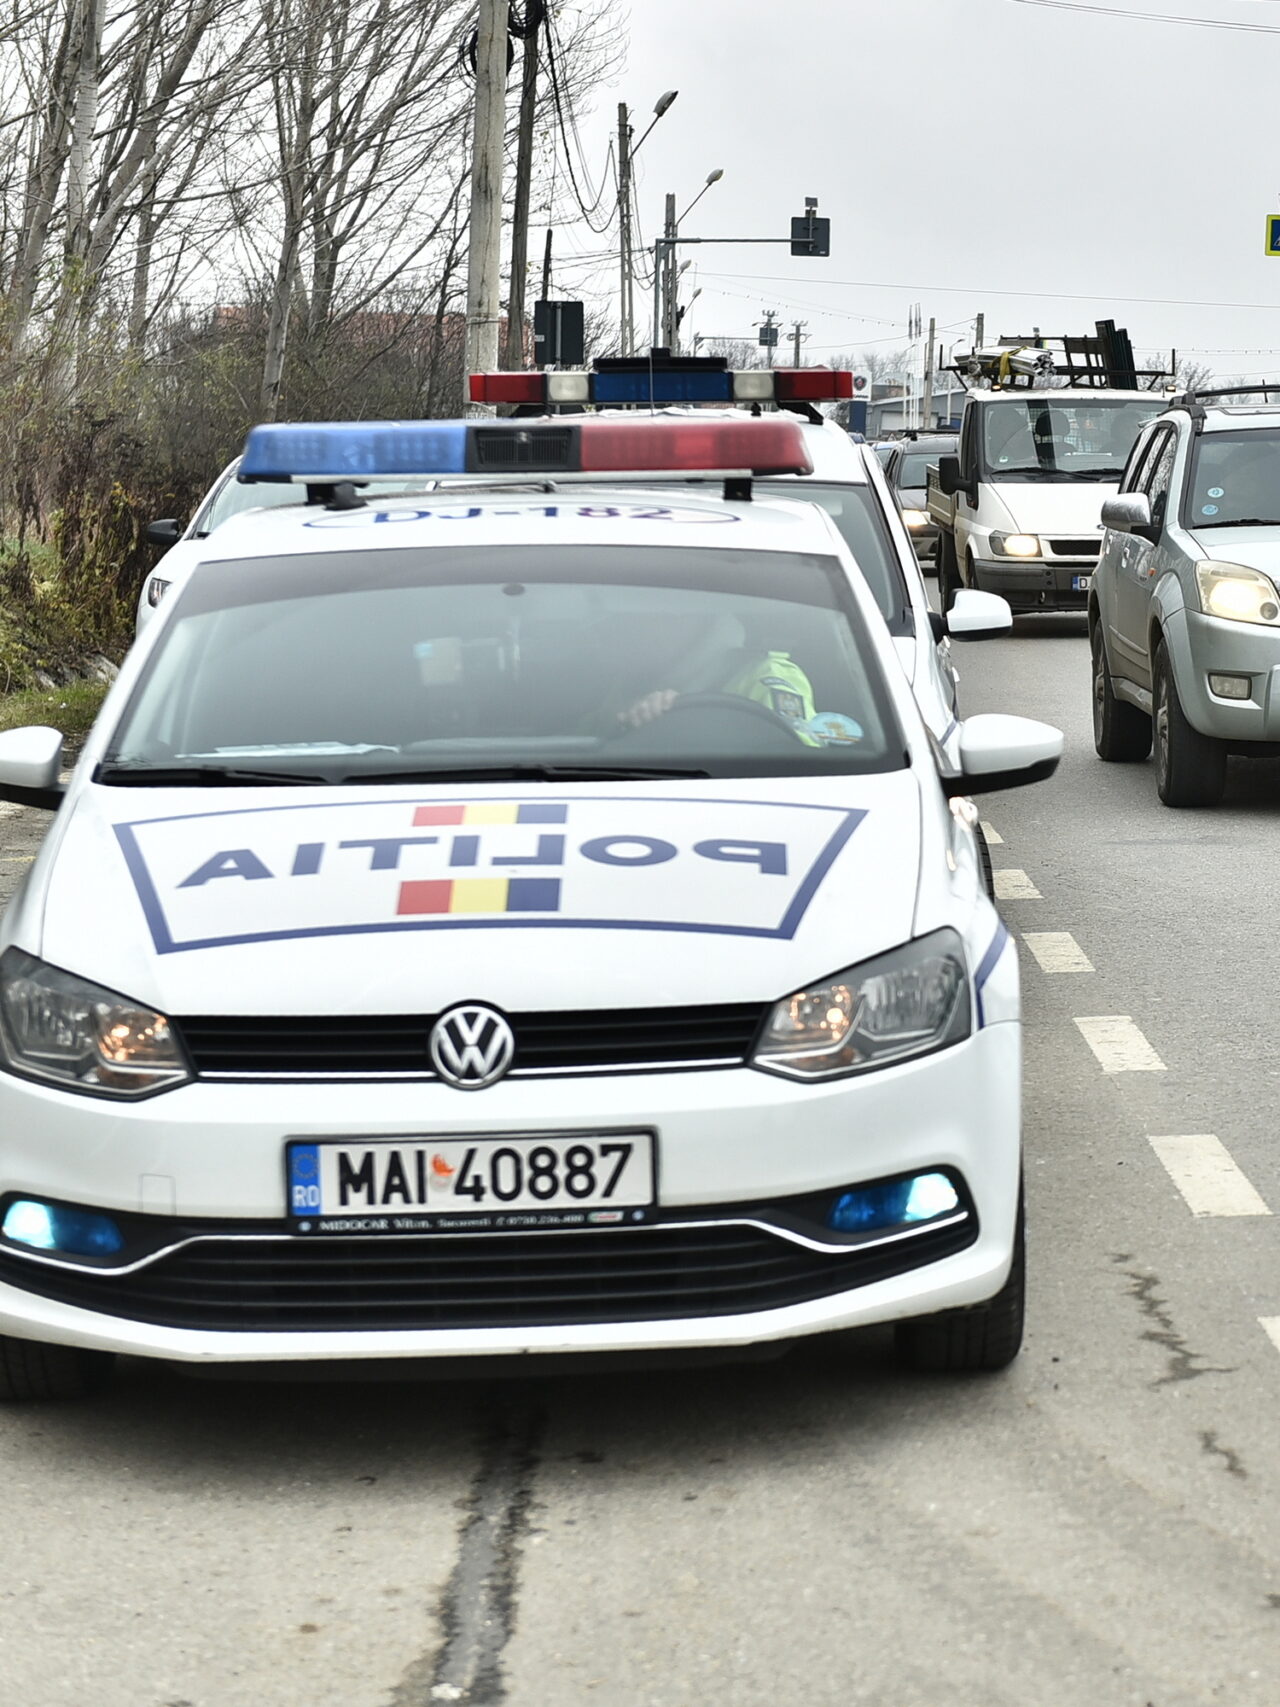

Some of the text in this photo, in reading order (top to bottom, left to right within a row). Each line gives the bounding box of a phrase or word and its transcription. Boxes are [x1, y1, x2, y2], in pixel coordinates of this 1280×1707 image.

[374, 506, 673, 523] DJ-182
[336, 1143, 635, 1206] MAI 40887
[293, 1184, 320, 1208] RO
